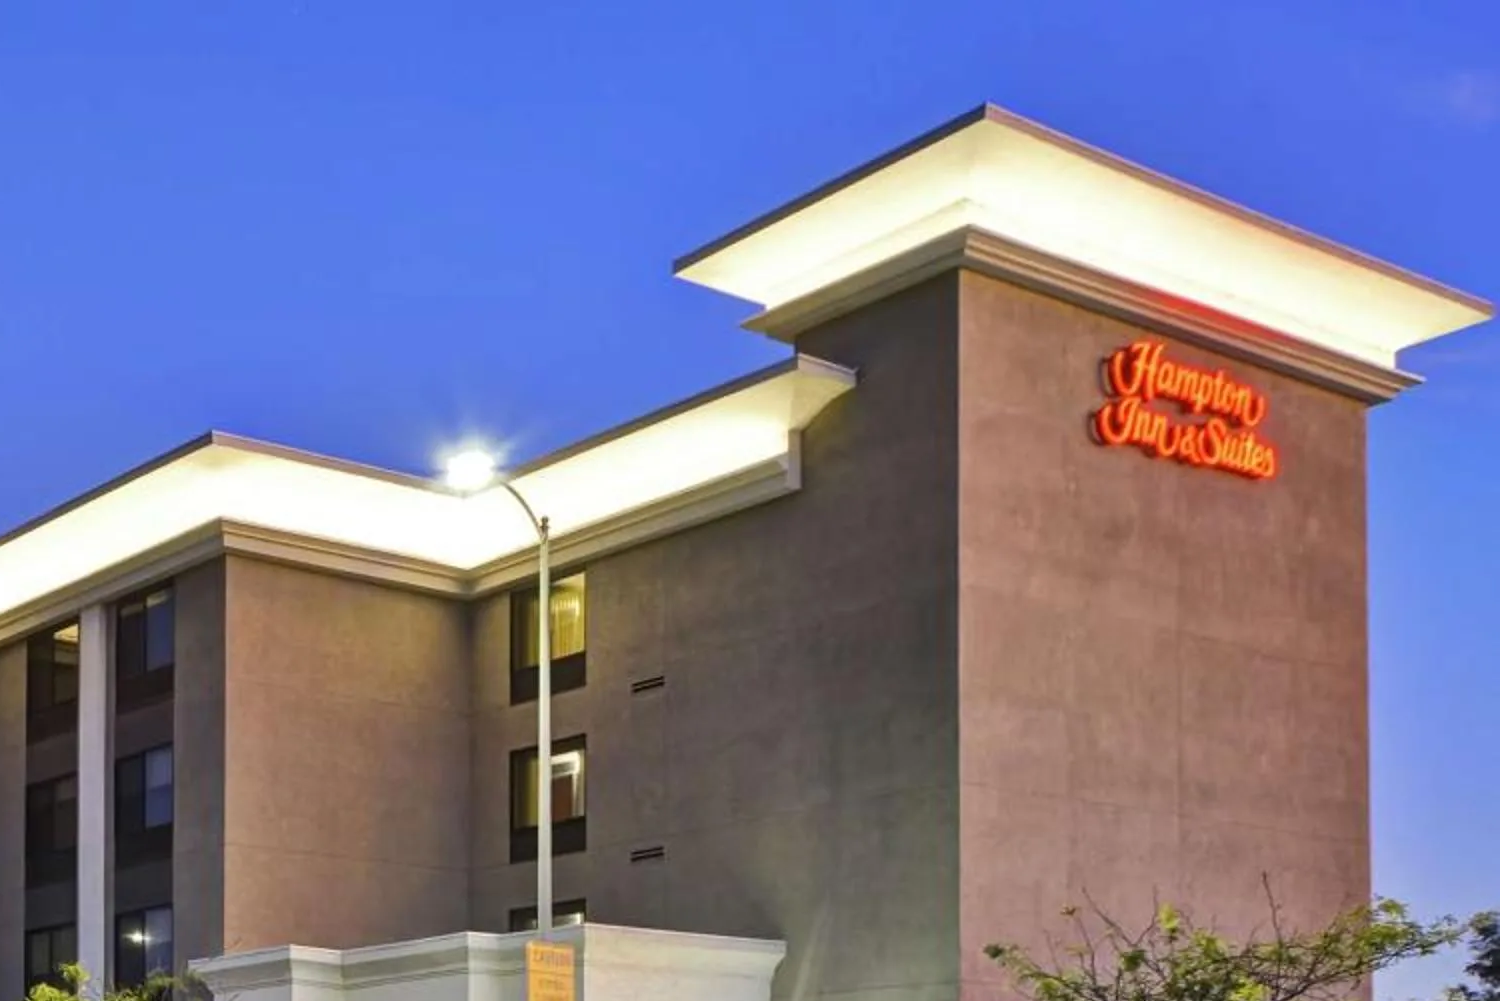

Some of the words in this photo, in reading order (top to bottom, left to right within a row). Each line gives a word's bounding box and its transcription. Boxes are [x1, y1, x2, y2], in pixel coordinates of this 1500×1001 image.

[1109, 341, 1265, 427] Hampton
[1098, 397, 1181, 457] Inn
[1179, 424, 1202, 463] &
[1199, 417, 1276, 478] Suites
